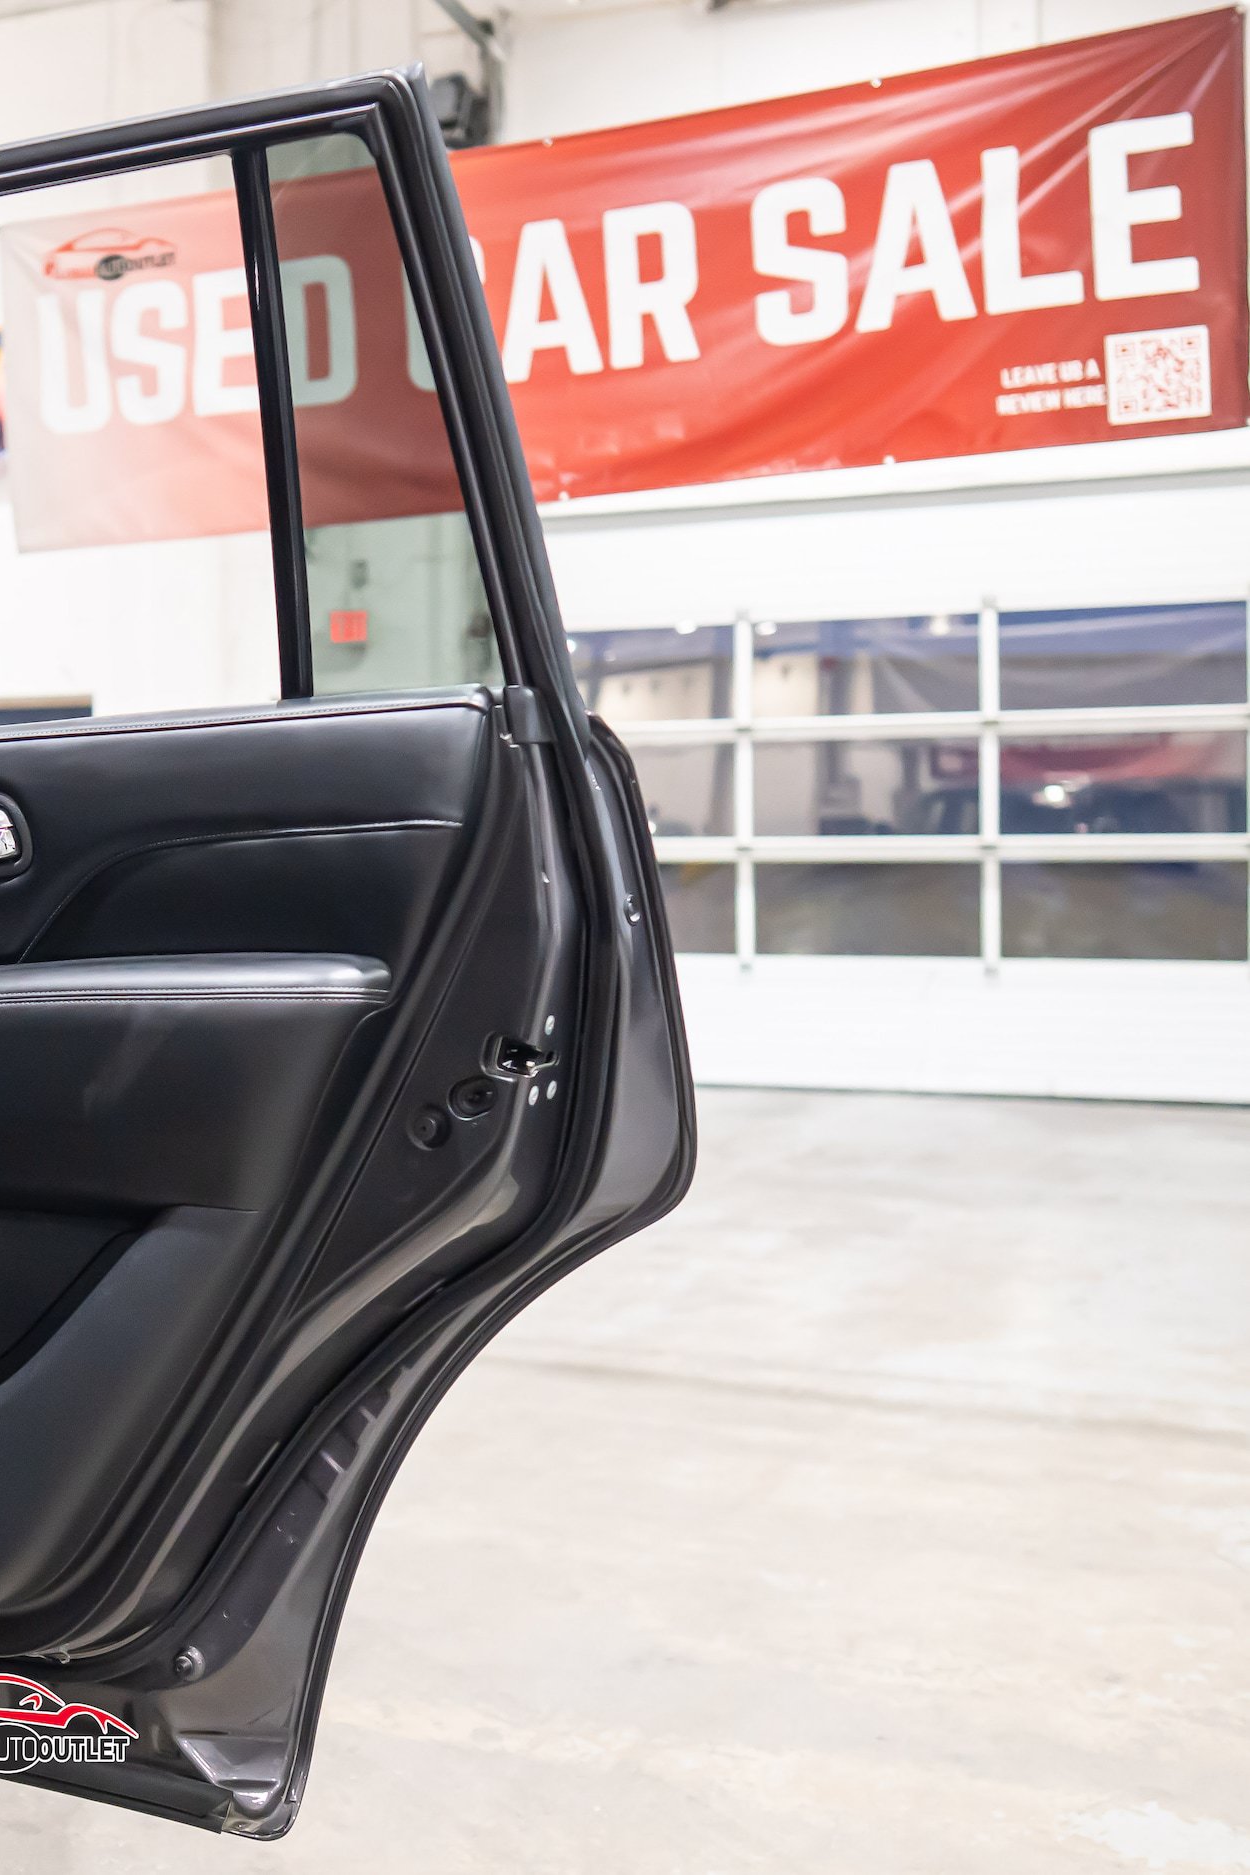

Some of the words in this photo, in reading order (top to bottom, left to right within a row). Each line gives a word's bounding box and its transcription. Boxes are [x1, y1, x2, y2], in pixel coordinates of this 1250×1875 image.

[37, 254, 357, 434] USED
[751, 111, 1201, 348] SALE
[1000, 362, 1058, 389] LEAVE
[1085, 357, 1101, 379] A
[996, 389, 1061, 416] REVIEW
